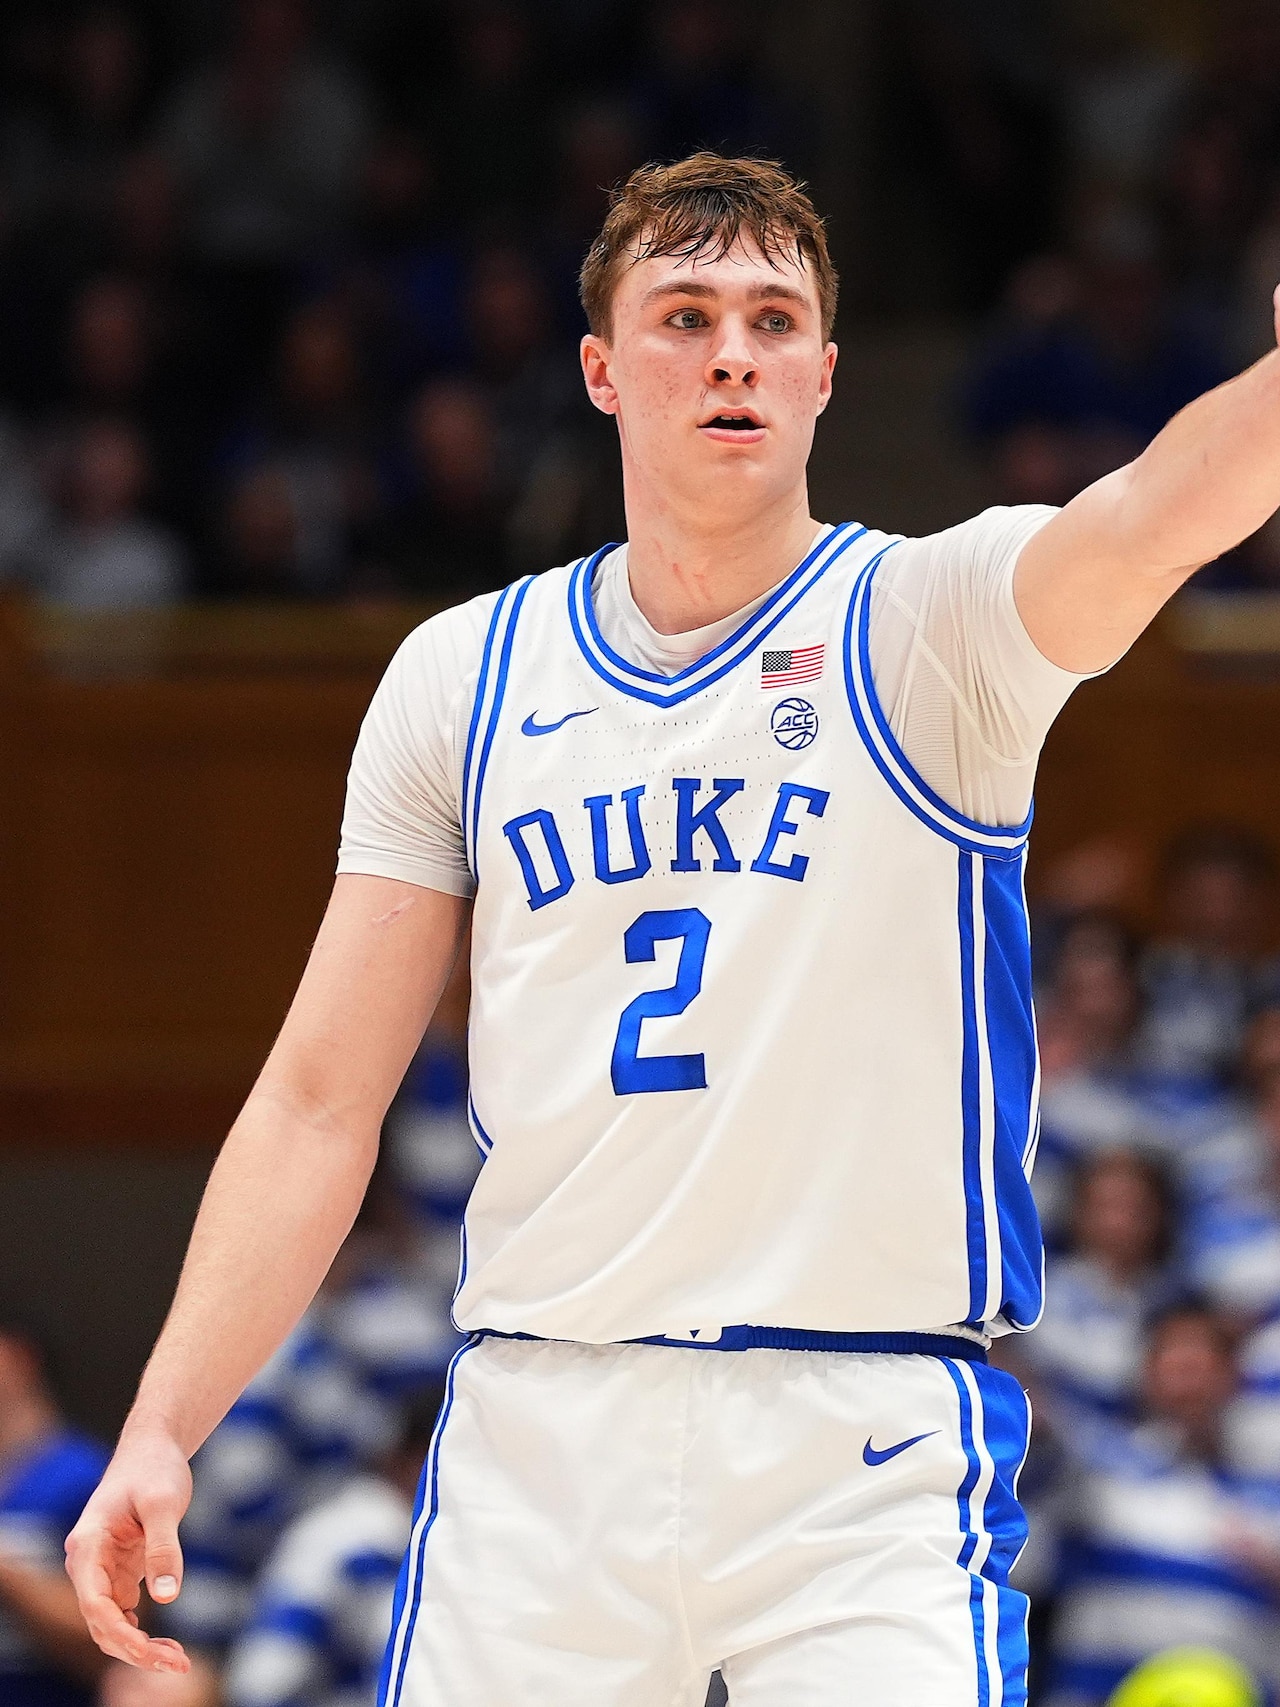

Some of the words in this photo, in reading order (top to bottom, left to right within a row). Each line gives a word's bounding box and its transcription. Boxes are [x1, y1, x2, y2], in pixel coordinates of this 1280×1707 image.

[777, 712, 816, 728] ACC
[503, 778, 830, 911] DUKE
[610, 907, 711, 1096] 2
